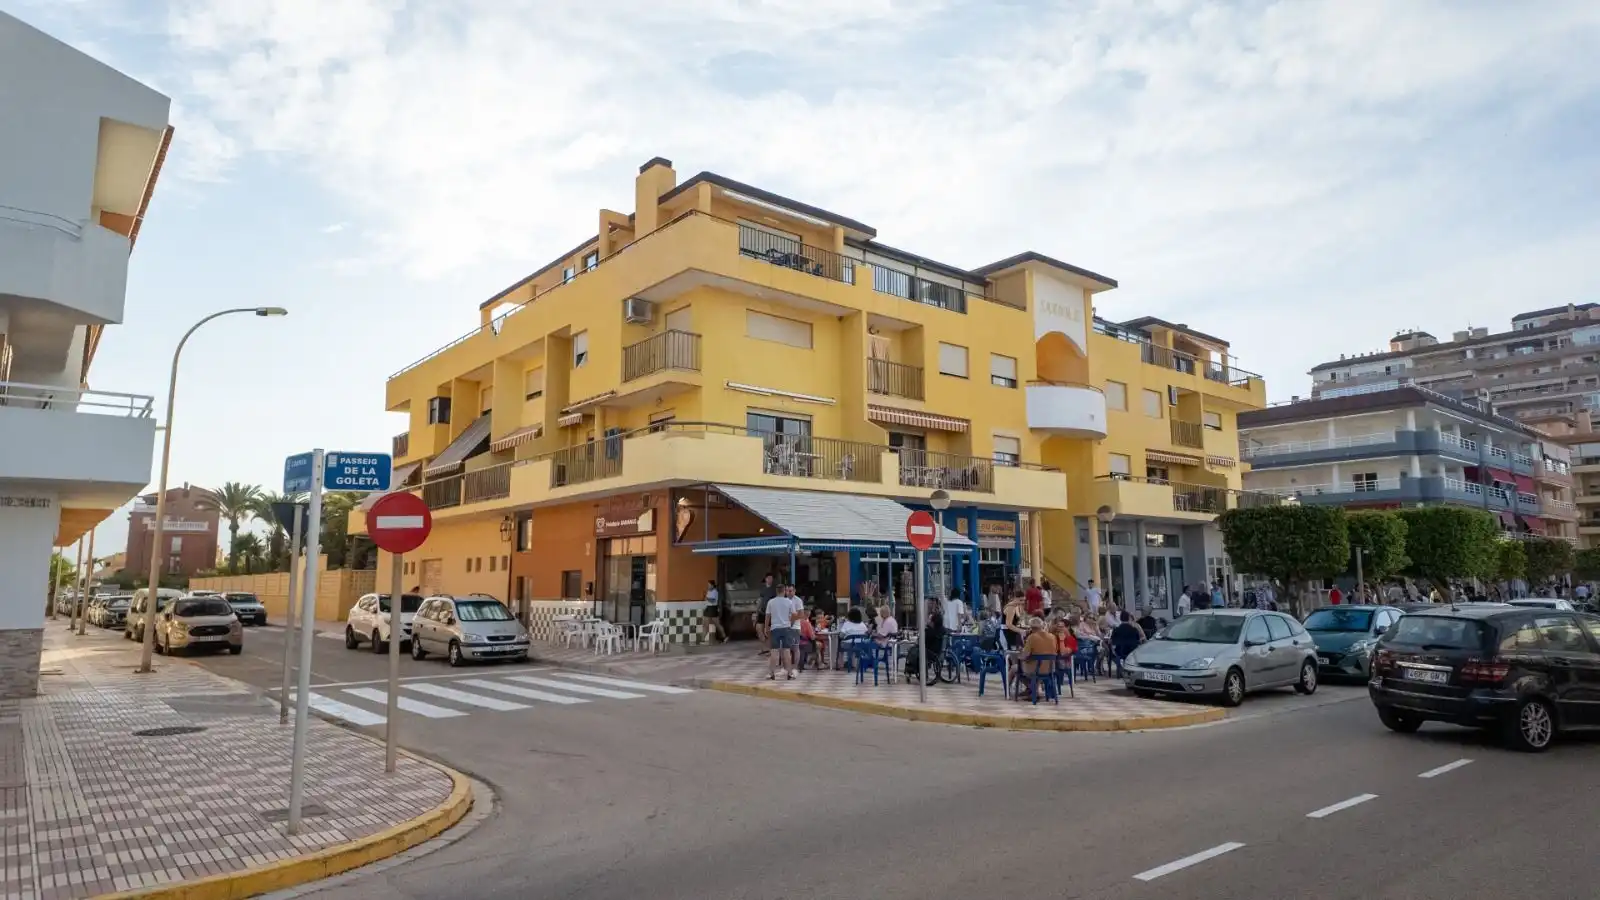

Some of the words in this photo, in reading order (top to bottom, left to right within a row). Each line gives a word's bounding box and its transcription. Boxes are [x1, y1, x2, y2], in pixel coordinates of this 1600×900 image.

[344, 467, 359, 475] DE
[362, 467, 376, 475] LA
[336, 477, 379, 485] GOLETA
